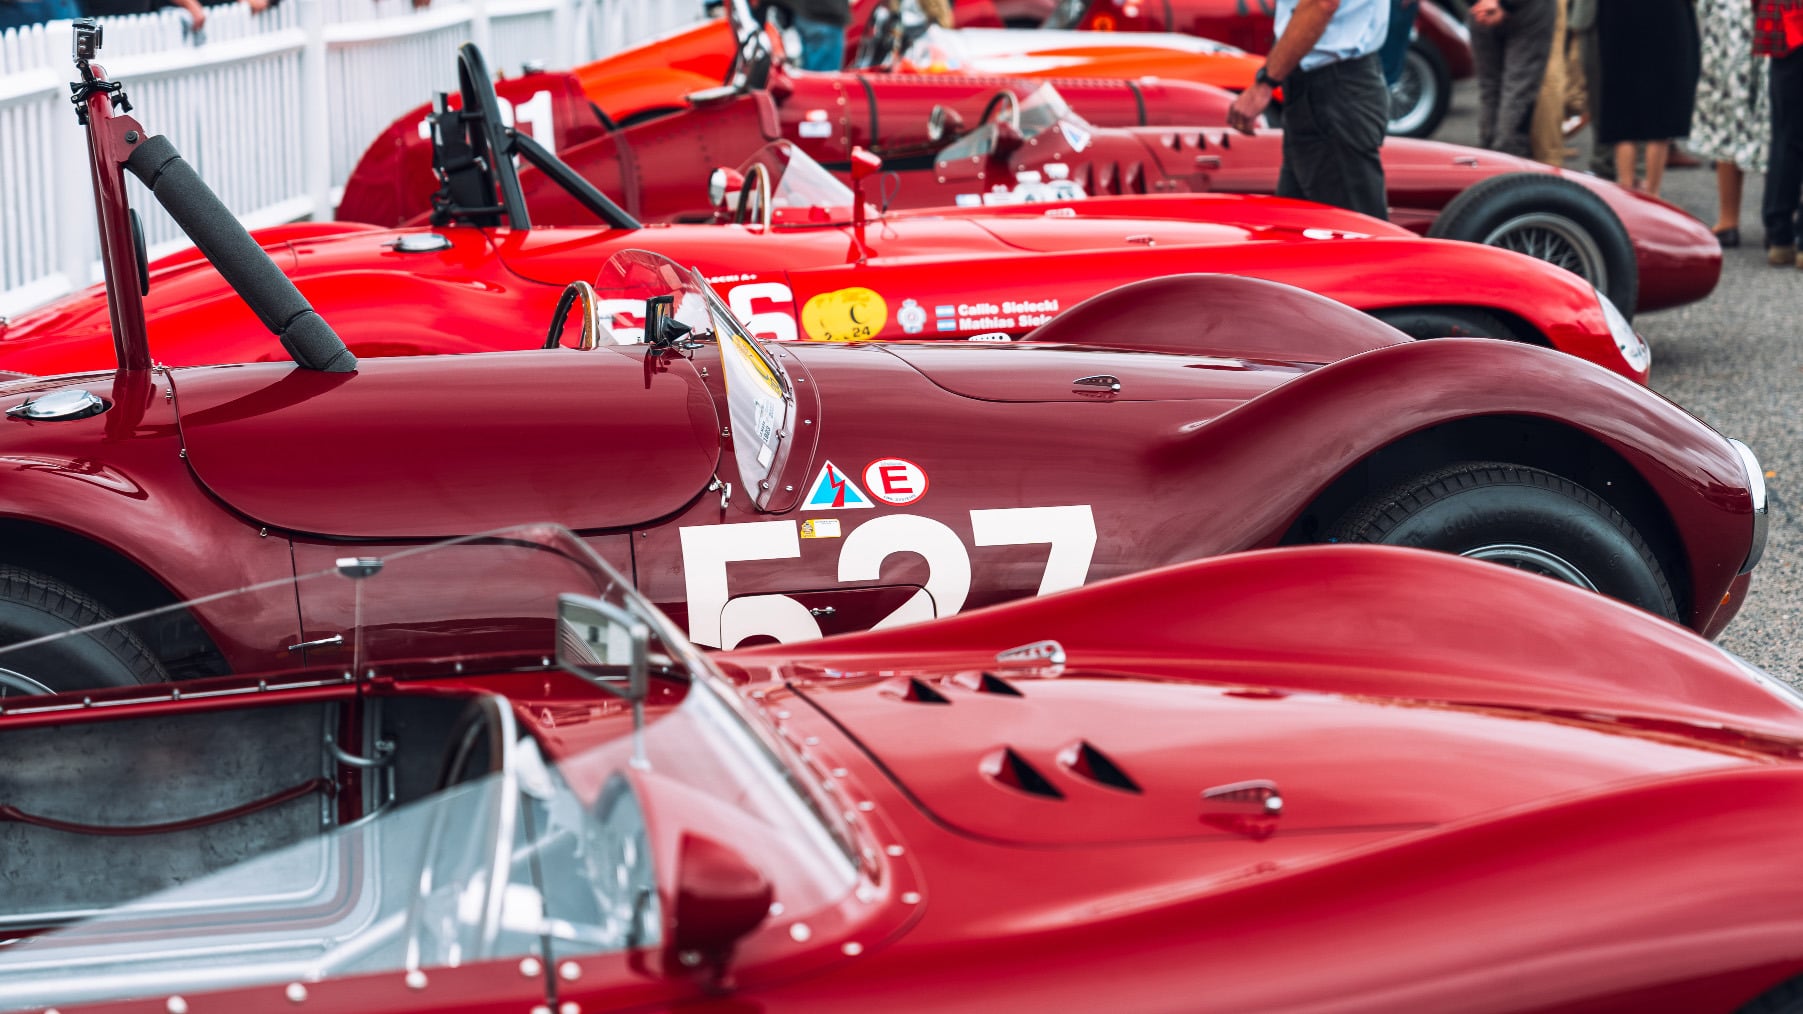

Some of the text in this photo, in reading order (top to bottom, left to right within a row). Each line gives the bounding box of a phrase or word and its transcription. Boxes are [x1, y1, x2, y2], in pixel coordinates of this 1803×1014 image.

[1002, 299, 1059, 314] Sielecki
[959, 316, 1014, 330] Mathias
[879, 466, 913, 494] E
[679, 504, 1098, 651] 527
